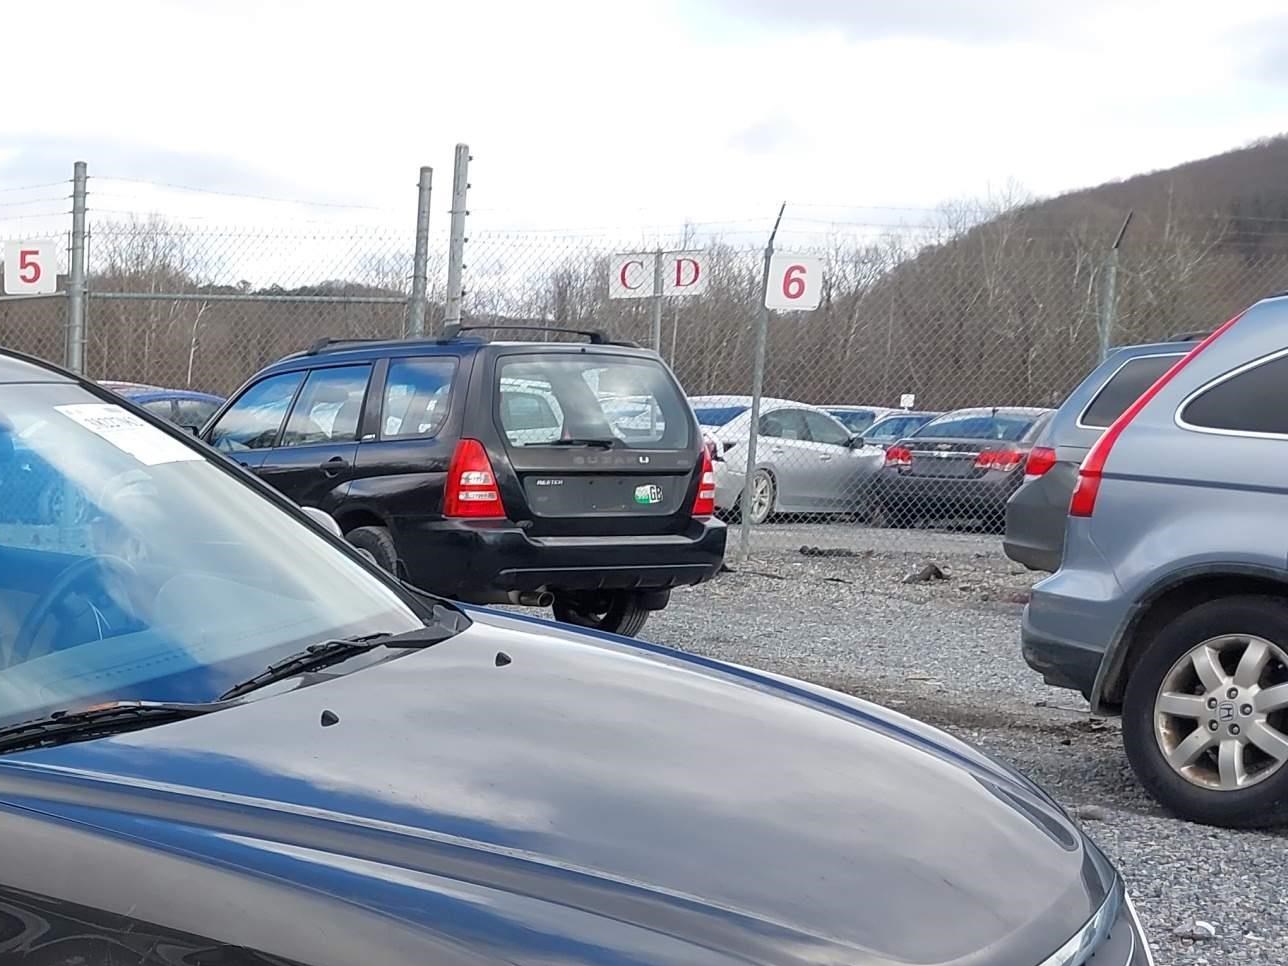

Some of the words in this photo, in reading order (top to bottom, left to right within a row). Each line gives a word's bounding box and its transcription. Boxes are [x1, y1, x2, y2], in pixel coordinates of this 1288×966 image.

[19, 250, 41, 283] 5
[620, 260, 644, 290] C
[674, 258, 700, 287] D
[782, 264, 808, 300] 6
